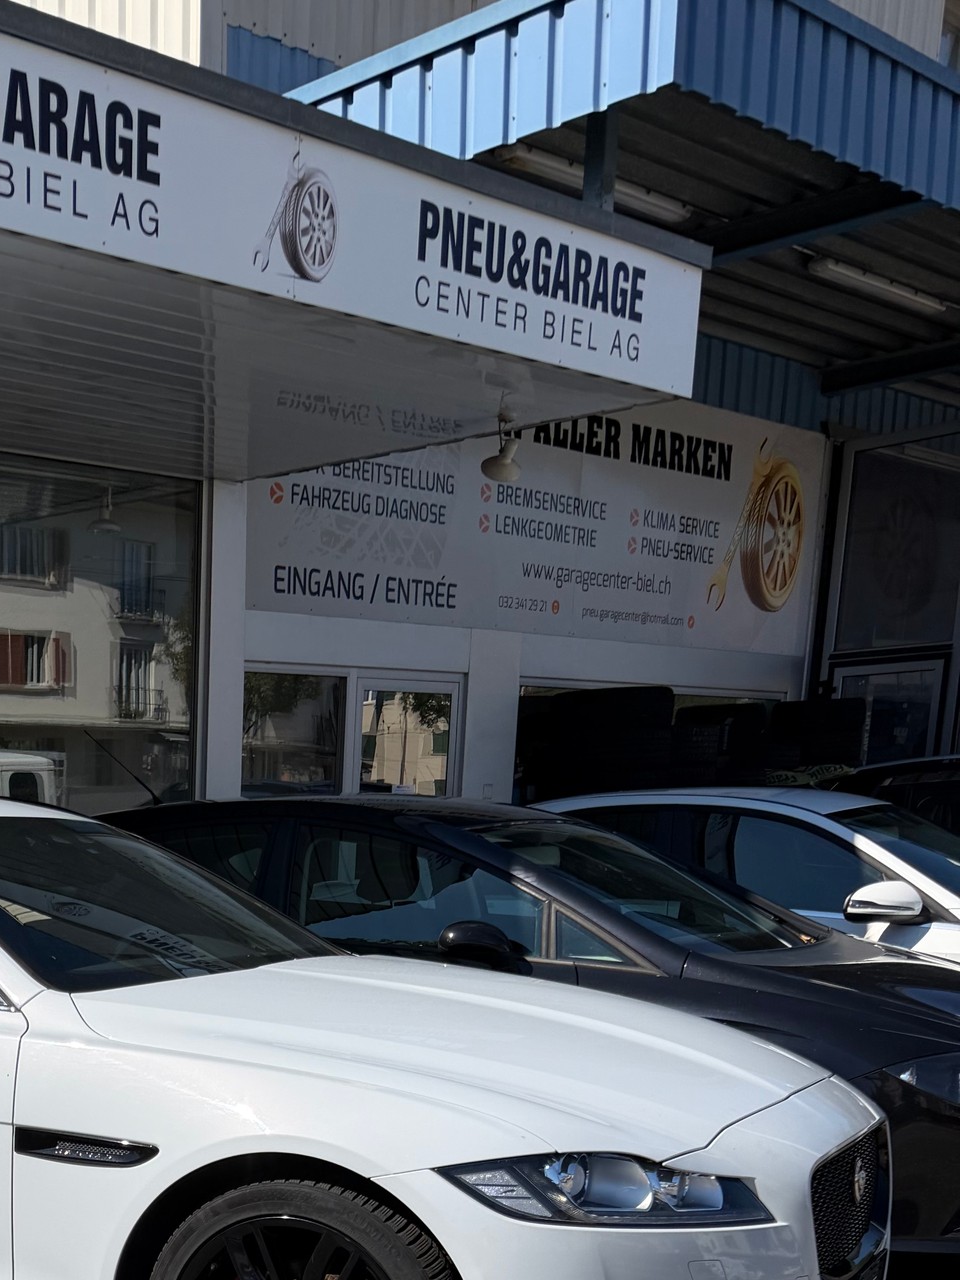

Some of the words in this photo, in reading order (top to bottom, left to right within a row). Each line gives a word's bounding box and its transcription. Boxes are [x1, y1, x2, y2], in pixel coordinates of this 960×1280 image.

[111, 193, 160, 238] AG
[416, 199, 646, 323] PNEU&GARAGE
[414, 276, 528, 333] CENTER
[543, 311, 597, 351] BIEL
[610, 329, 640, 362] AG
[533, 415, 621, 460] ALLER
[630, 423, 733, 481] MARKEN
[290, 483, 371, 514] FAHRZEUG
[375, 495, 446, 525] DIAGNOSE
[496, 483, 607, 521] BREMSENSERVICE
[495, 513, 597, 548] LENKGEOMETRIE
[642, 509, 676, 532] KLIMA
[679, 515, 721, 539] SERVICE
[640, 537, 715, 565] PNEU-SERVICE
[273, 565, 365, 600] EINGANG
[369, 573, 380, 604] /
[385, 575, 458, 609] ENTRÉE
[521, 562, 672, 595] www.garagecenter-biel.ch
[498, 595, 513, 609] 032
[514, 597, 527, 610] 341
[528, 599, 538, 611] 29
[540, 600, 547, 612] 21
[581, 606, 684, 627] pneu.garagecenter@hotmail.com
